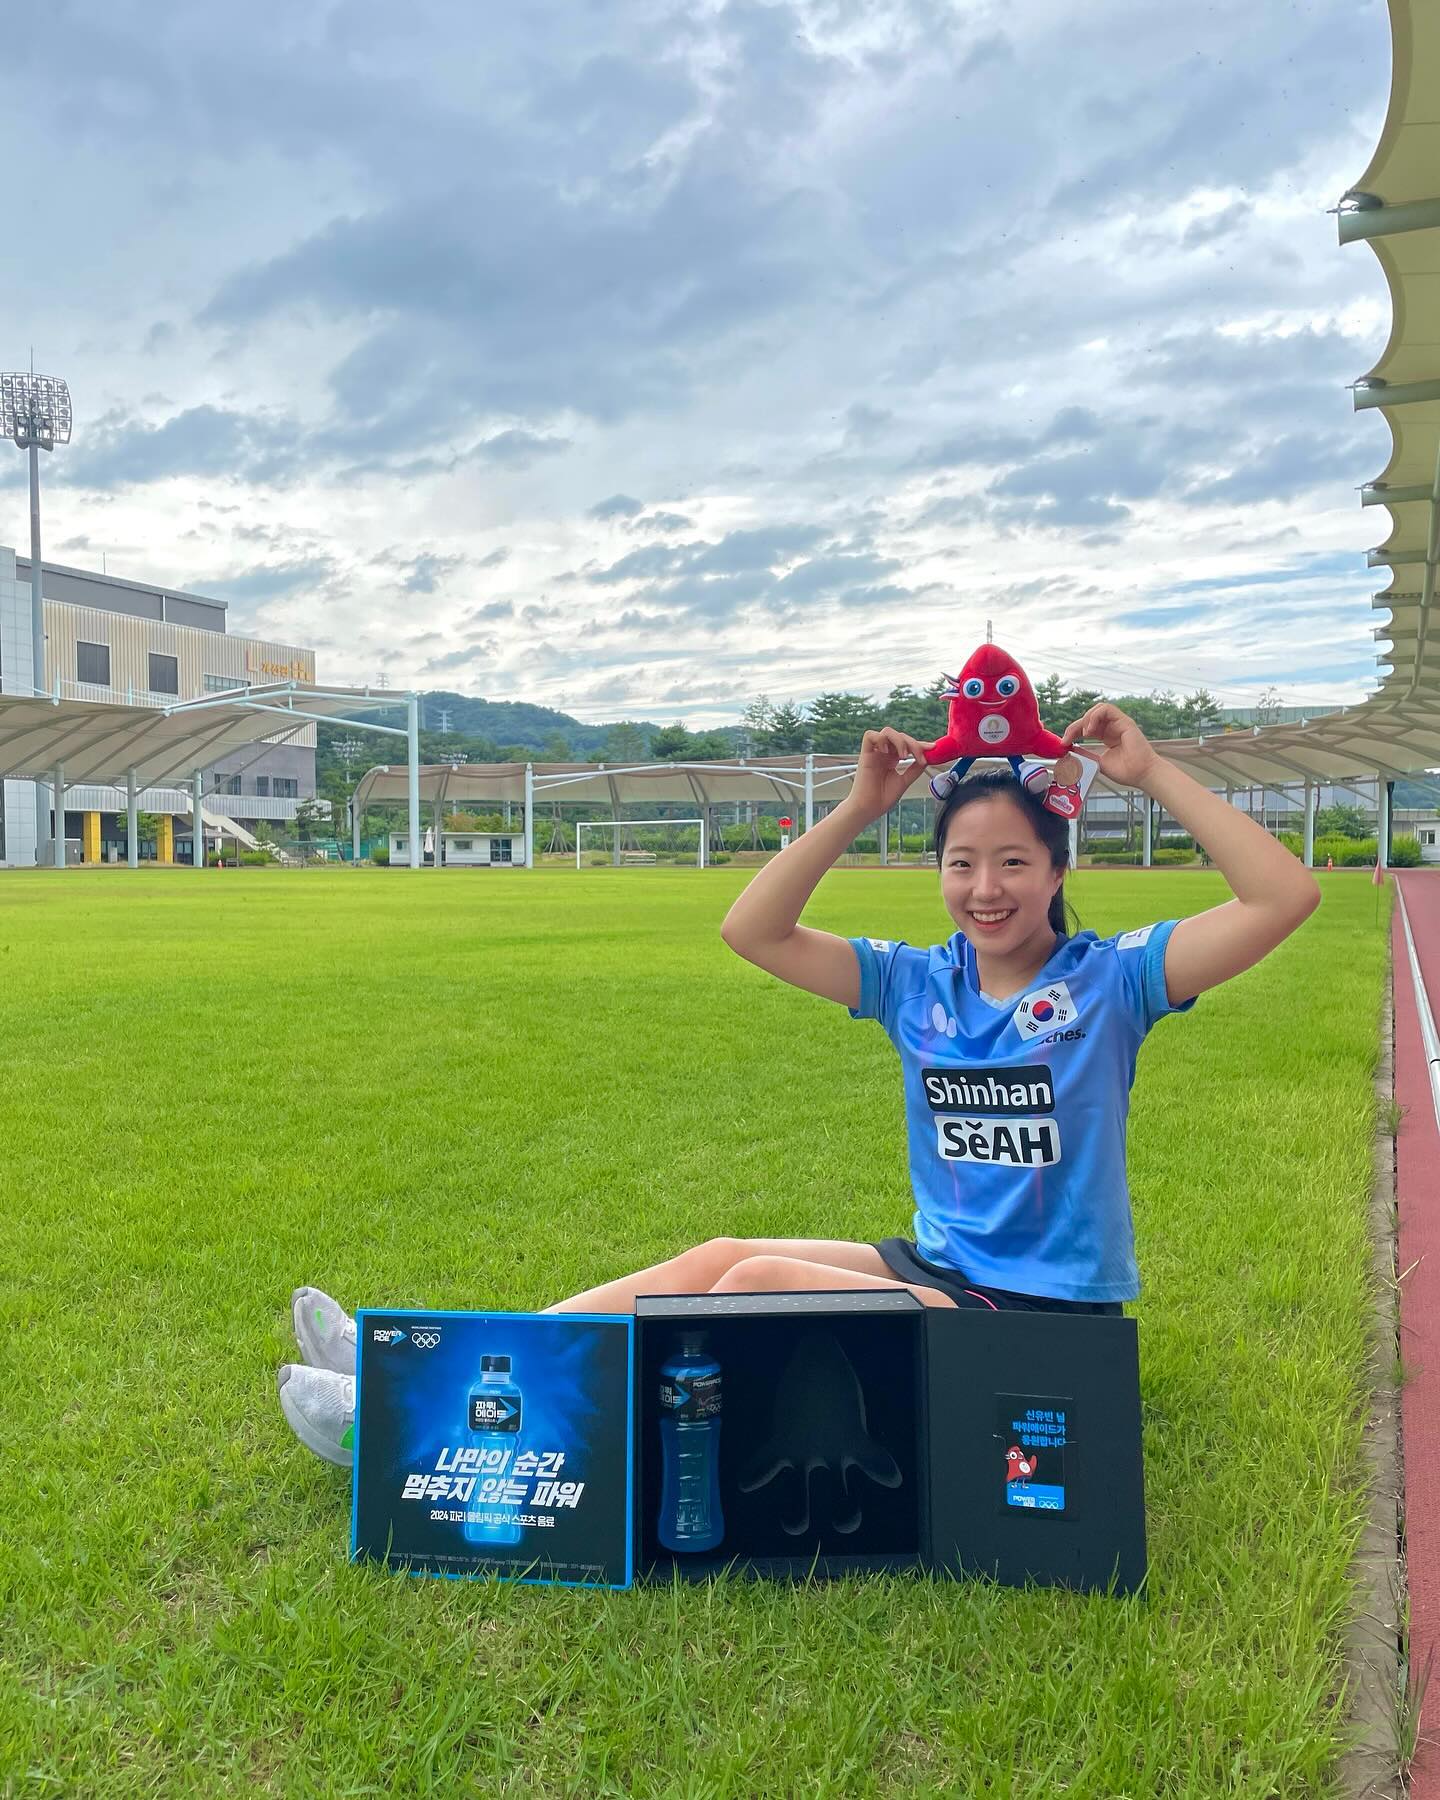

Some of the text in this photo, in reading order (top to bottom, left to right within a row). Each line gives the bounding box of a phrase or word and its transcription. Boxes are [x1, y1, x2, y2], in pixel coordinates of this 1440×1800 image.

[1041, 1028, 1087, 1044] ches.
[926, 1076, 1051, 1106] Shinhan
[475, 1401, 497, 1410] 파워
[475, 1409, 511, 1418] 에이드
[1026, 1410, 1065, 1423] 신유빈 님
[1012, 1421, 1066, 1436] 파워에이드가
[1022, 1435, 1066, 1448] 응원합니다
[434, 1447, 565, 1478] 나만의 순간
[401, 1474, 585, 1508] 멈추지 않는 파워
[430, 1510, 555, 1528] 2024 파리 올림픽 공식 스포츠 음료
